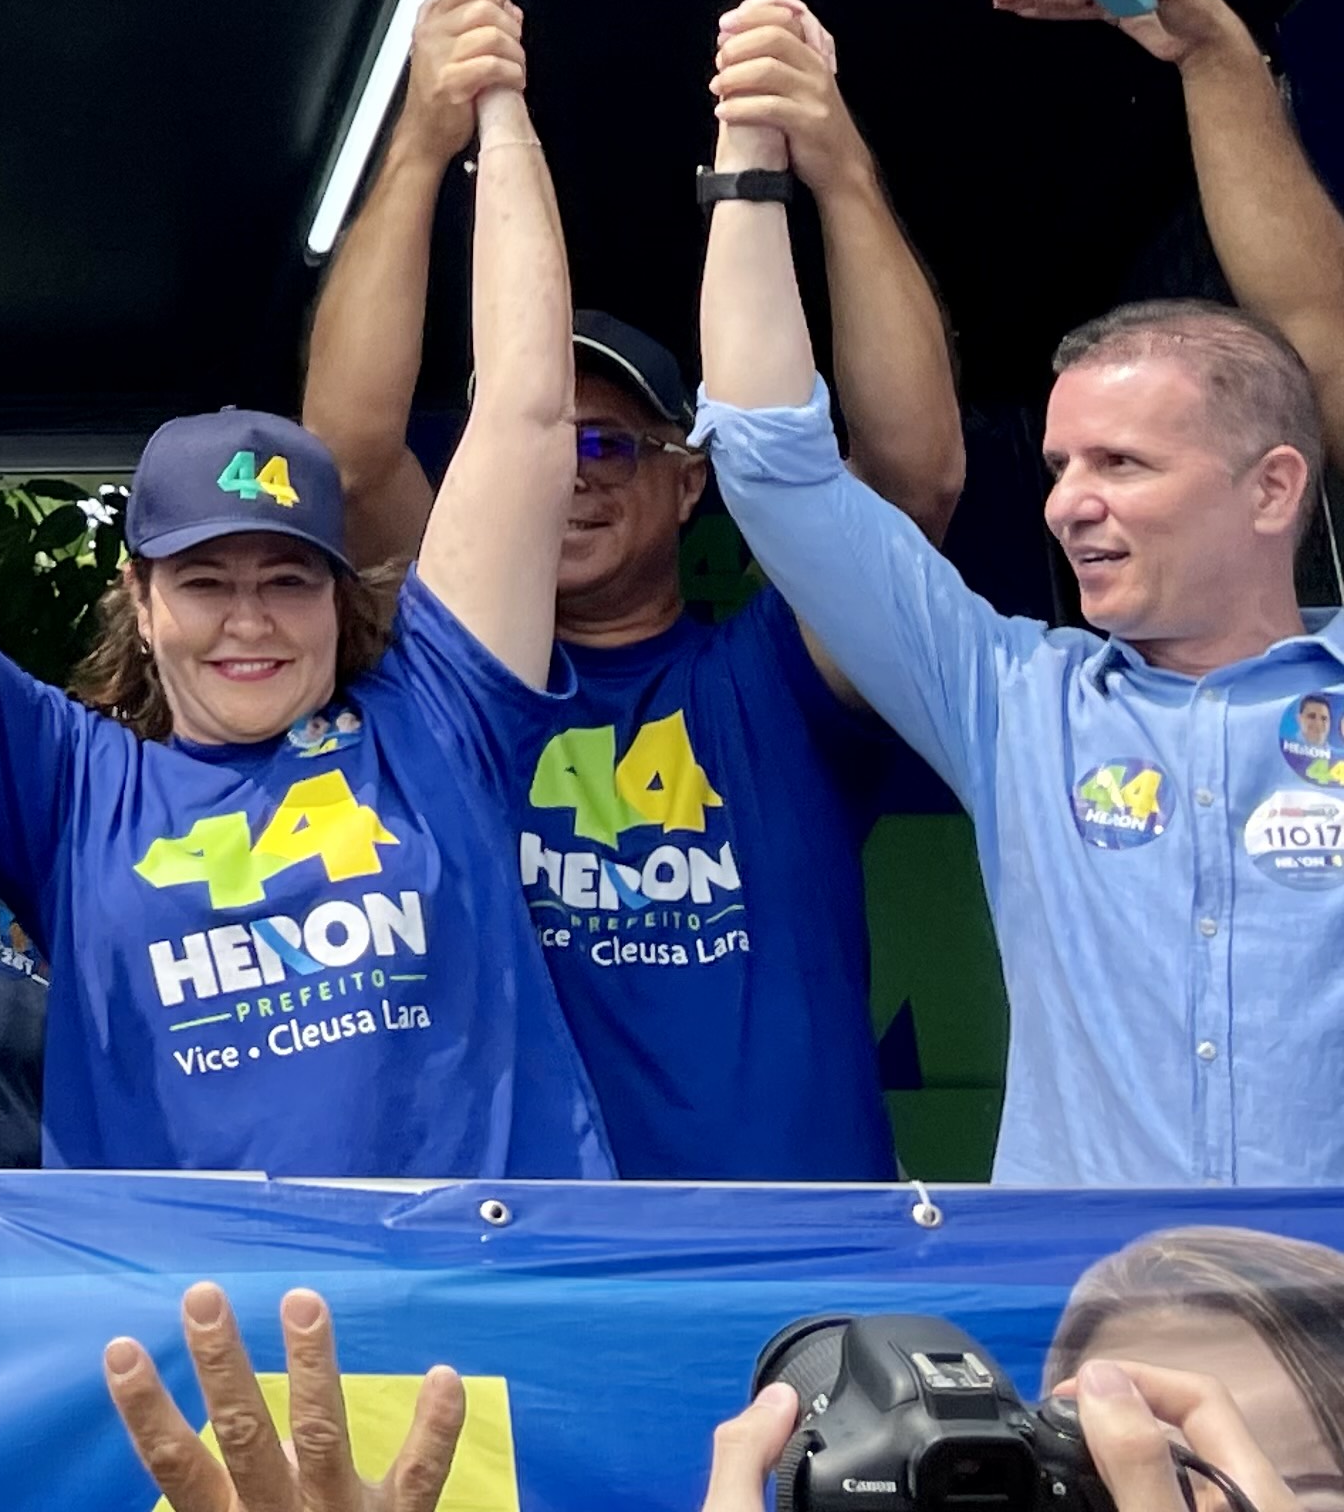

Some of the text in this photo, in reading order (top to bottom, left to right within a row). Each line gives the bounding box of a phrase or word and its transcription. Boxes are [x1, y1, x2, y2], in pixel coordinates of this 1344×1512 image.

[217, 451, 301, 508] 44
[529, 707, 724, 852] 44
[1080, 765, 1161, 819] 44
[133, 768, 402, 911] 44
[1264, 824, 1343, 848] 11017
[520, 831, 742, 912] HERON
[148, 890, 428, 1007] HERON
[570, 911, 701, 934] PREFEITO
[591, 937, 689, 967] Cleusa
[696, 929, 751, 965] Lara
[236, 968, 386, 1023] PREFEITO
[173, 999, 432, 1076] Vice Cleusa Lara
[842, 1477, 898, 1494] Canon
